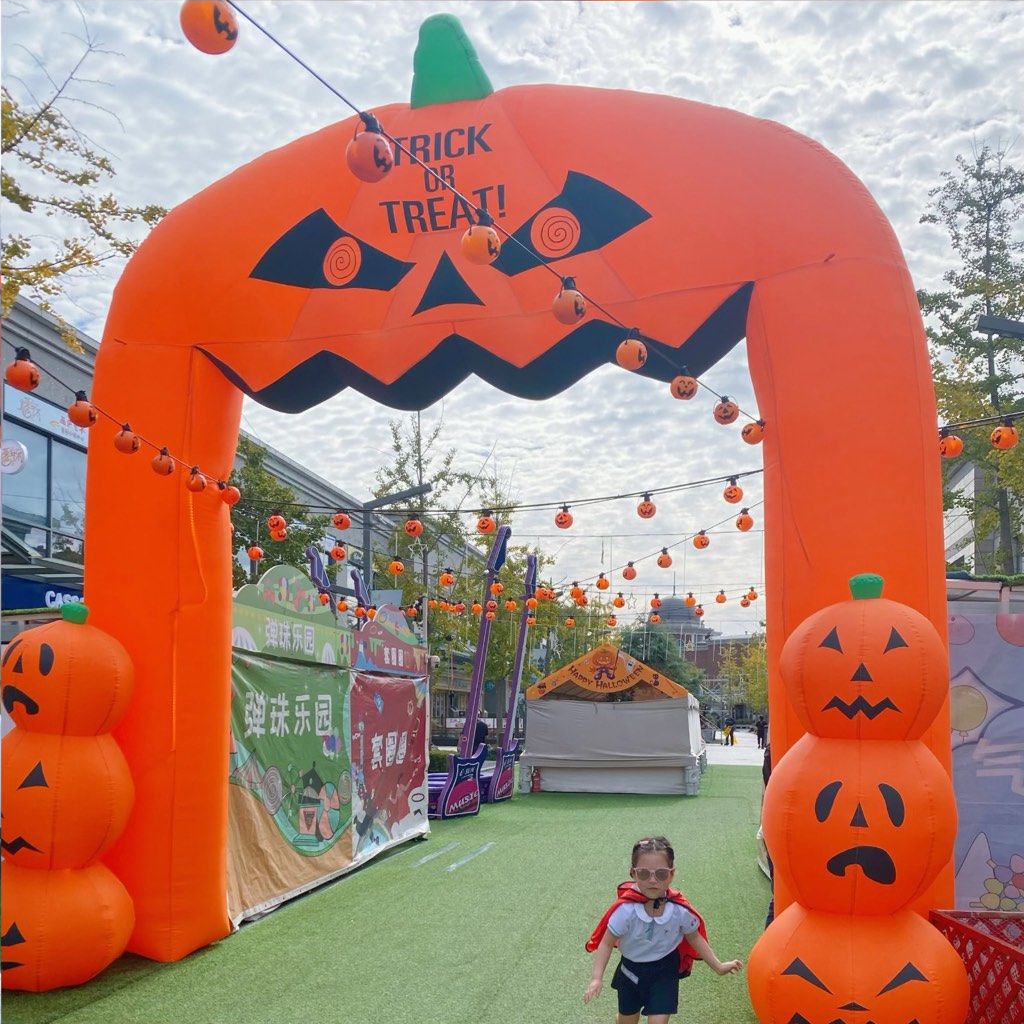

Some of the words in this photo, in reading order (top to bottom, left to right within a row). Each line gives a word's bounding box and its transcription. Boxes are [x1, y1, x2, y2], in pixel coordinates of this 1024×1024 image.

[392, 123, 493, 166] TRICK
[424, 164, 455, 192] OR
[378, 184, 507, 234] TREAT!
[568, 665, 594, 686] HAPPY
[596, 665, 644, 690] HALLOWEEN
[244, 691, 333, 738] 弹珠乐园
